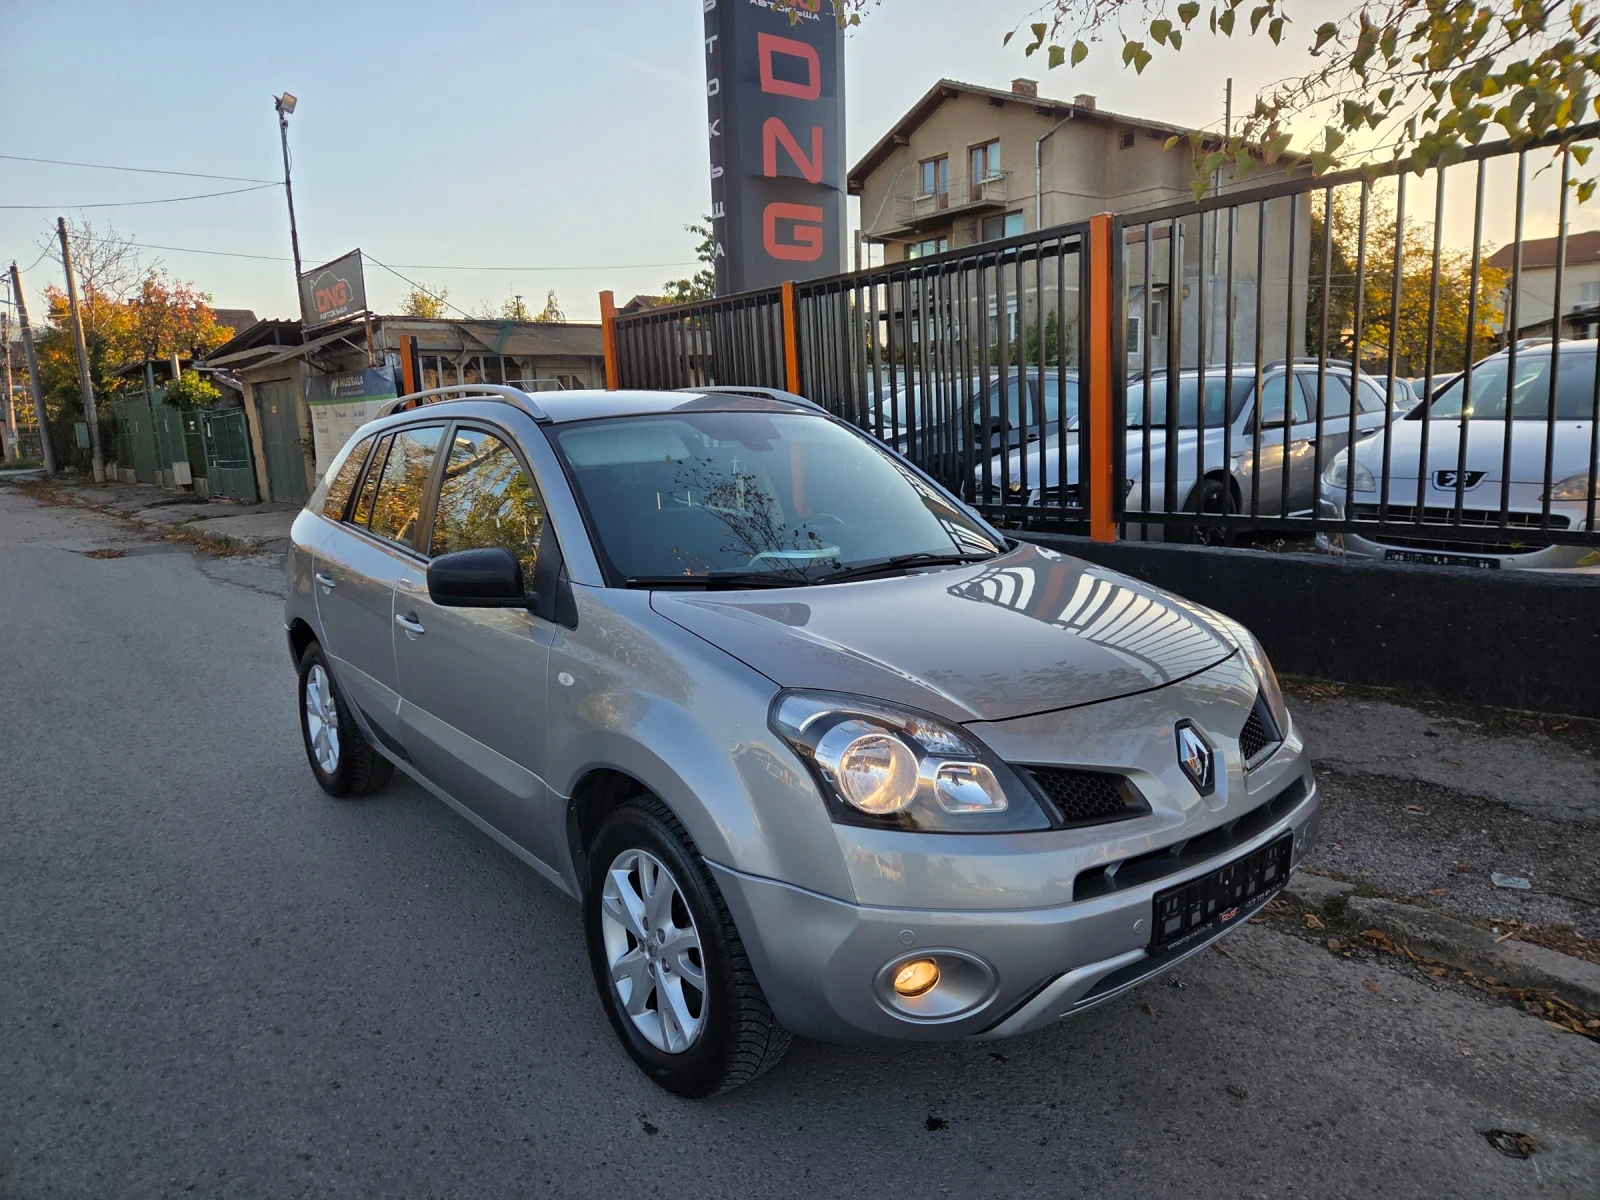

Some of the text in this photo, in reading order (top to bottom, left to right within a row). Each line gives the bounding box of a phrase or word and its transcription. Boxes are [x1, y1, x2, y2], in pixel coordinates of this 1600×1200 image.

[758, 32, 823, 261] DNG
[316, 282, 346, 312] DNG
[339, 375, 364, 388] MUSSALA
